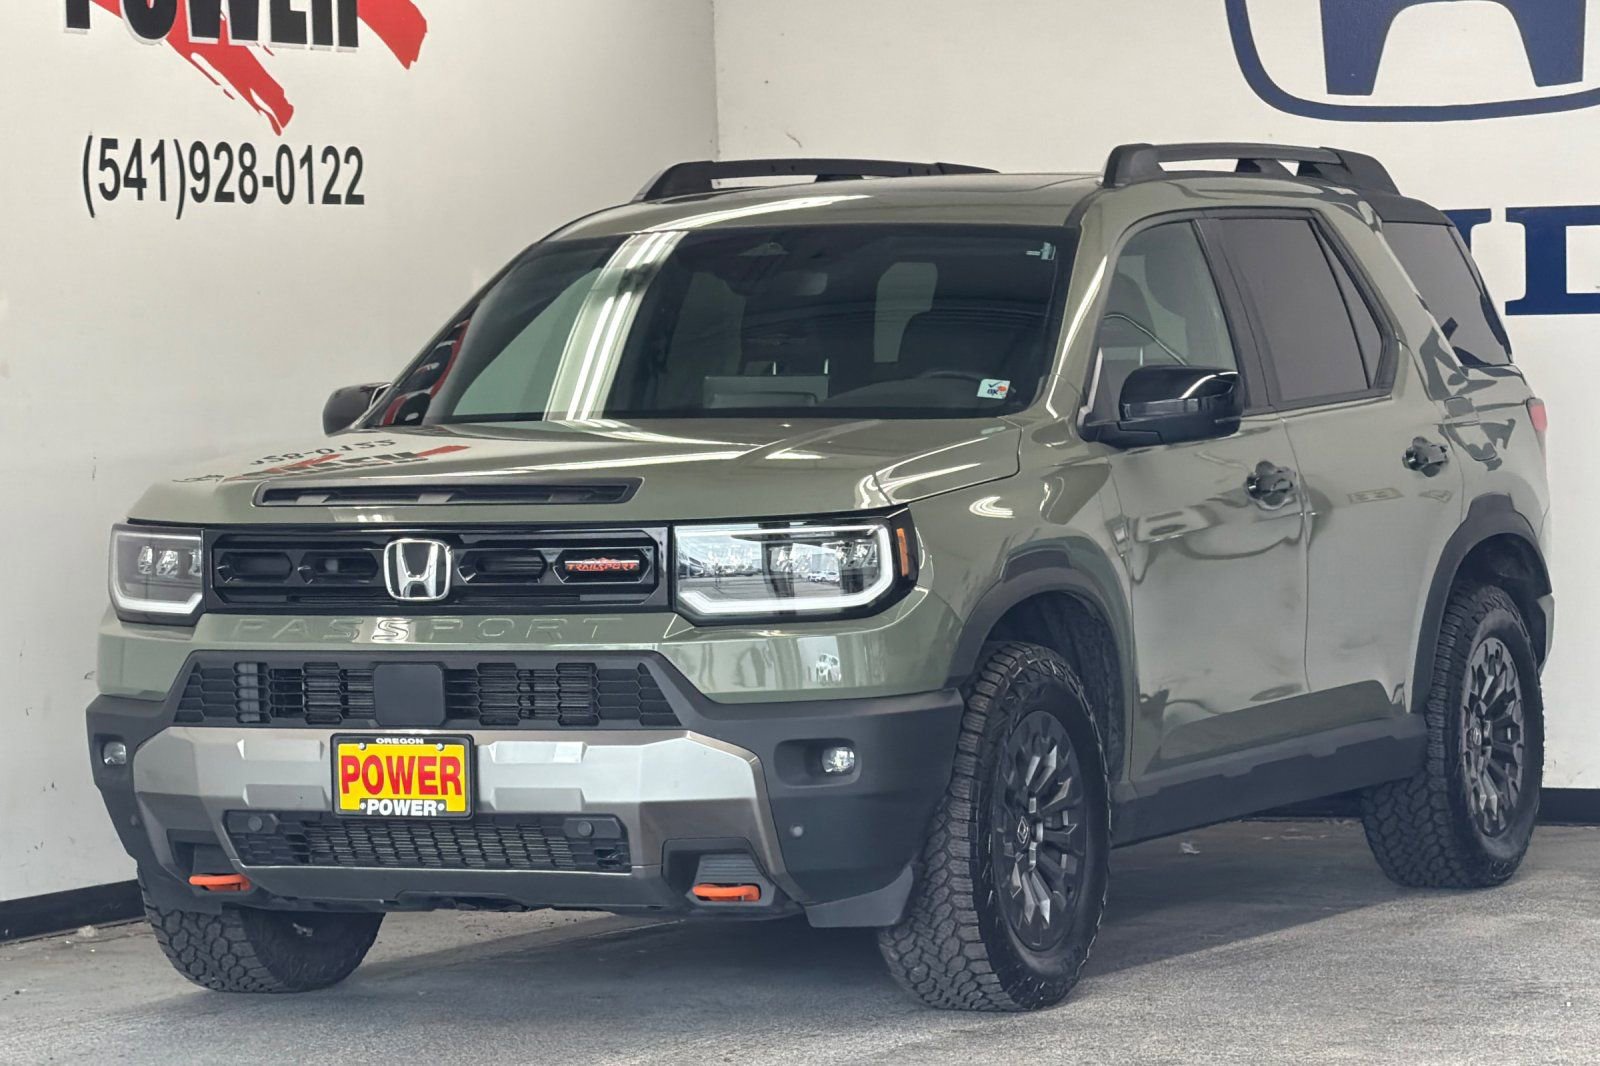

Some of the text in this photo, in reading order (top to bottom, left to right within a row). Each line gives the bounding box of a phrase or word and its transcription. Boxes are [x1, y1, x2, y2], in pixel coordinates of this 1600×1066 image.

[82, 133, 365, 220] (541)928-0122
[231, 617, 623, 642] PASSPORT
[375, 737, 424, 745] OREGON
[341, 755, 462, 796] POWER
[366, 798, 438, 817] POWER
